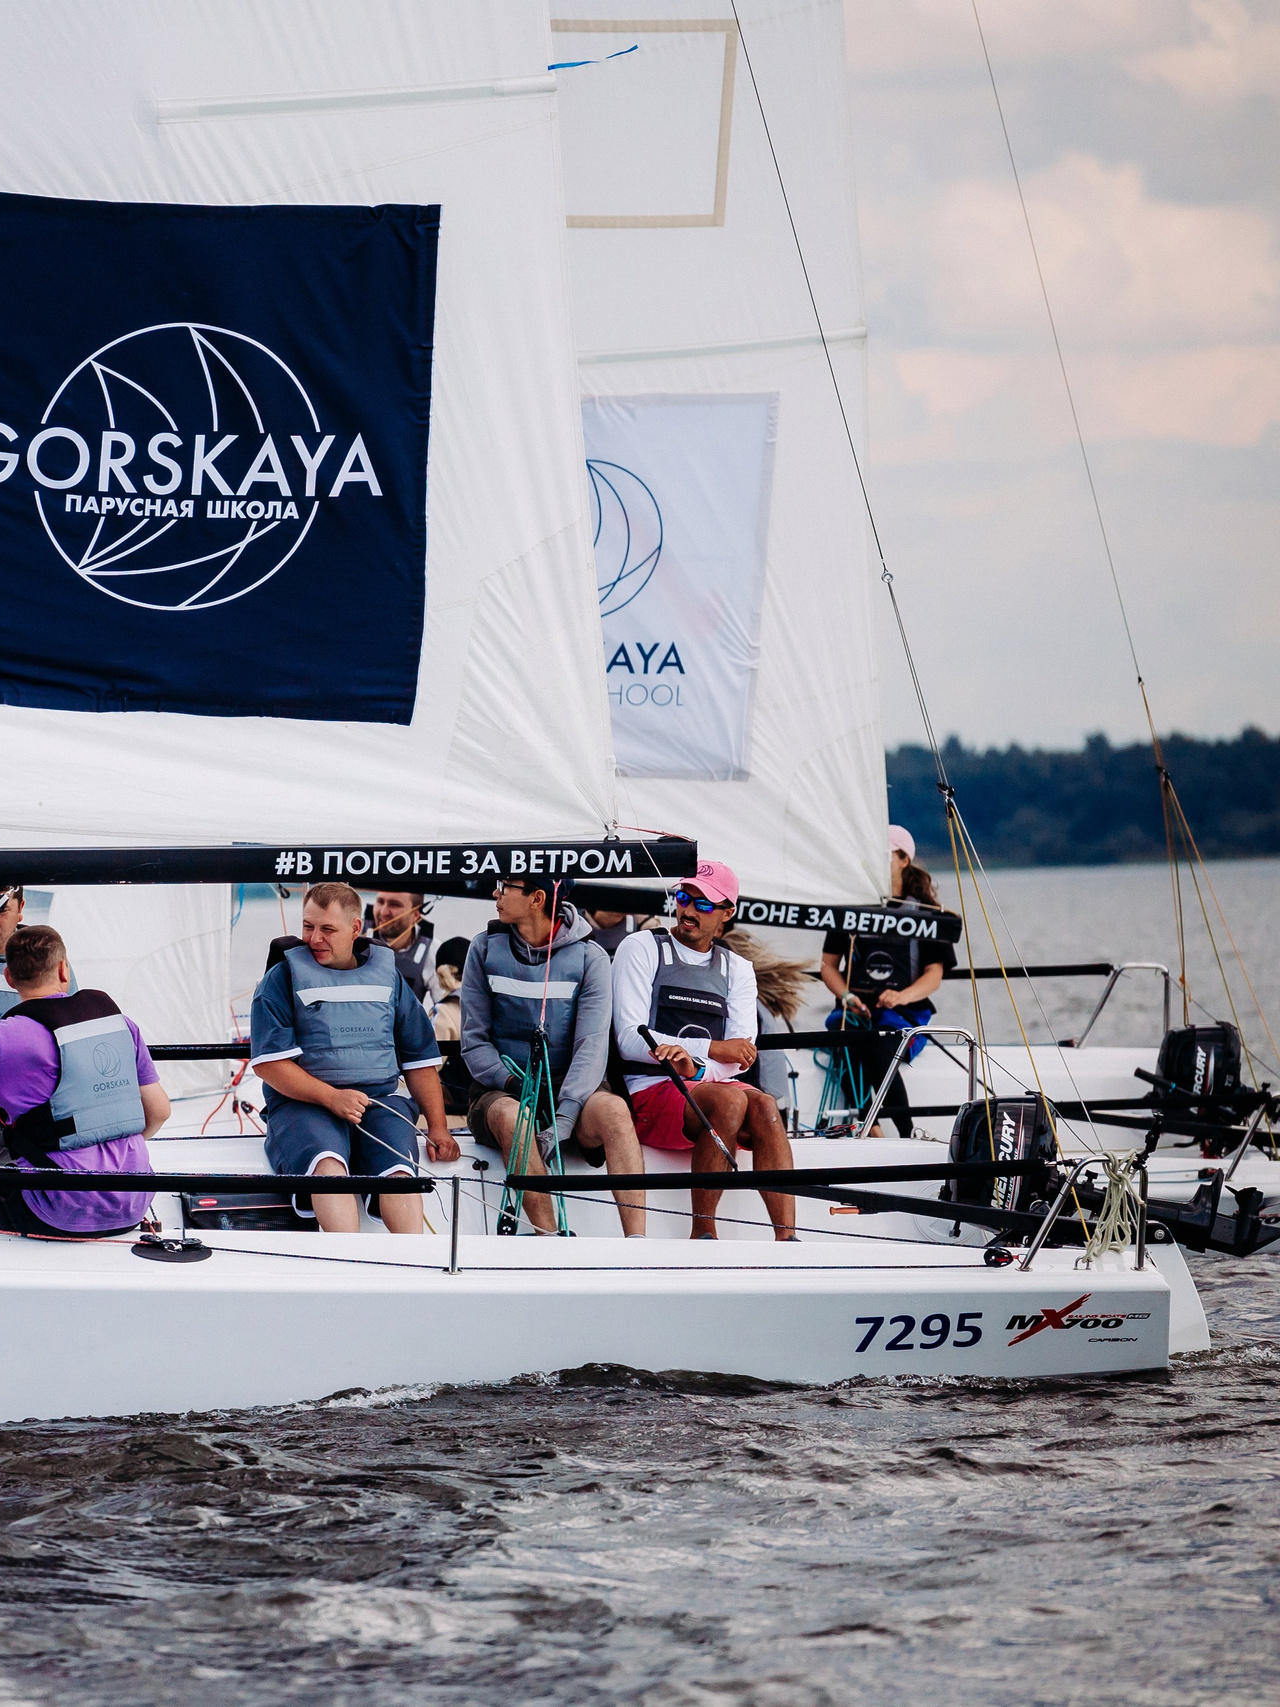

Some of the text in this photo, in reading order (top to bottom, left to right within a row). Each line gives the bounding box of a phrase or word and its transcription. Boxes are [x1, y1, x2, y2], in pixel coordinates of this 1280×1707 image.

[64, 494, 300, 520] ПАРУСНАЯ ШКОЛА
[604, 641, 686, 675] AYA
[274, 849, 634, 876] #В ПОГОНЕ ЗА ВЕТРОМ
[735, 901, 800, 926] ГОНЕ
[804, 907, 837, 929] ЗА
[842, 911, 938, 939] ВЕТРОМ
[340, 1026, 375, 1034] GORSKAYA
[93, 1078, 131, 1093] GORSKAYA
[855, 1312, 983, 1353] 7295
